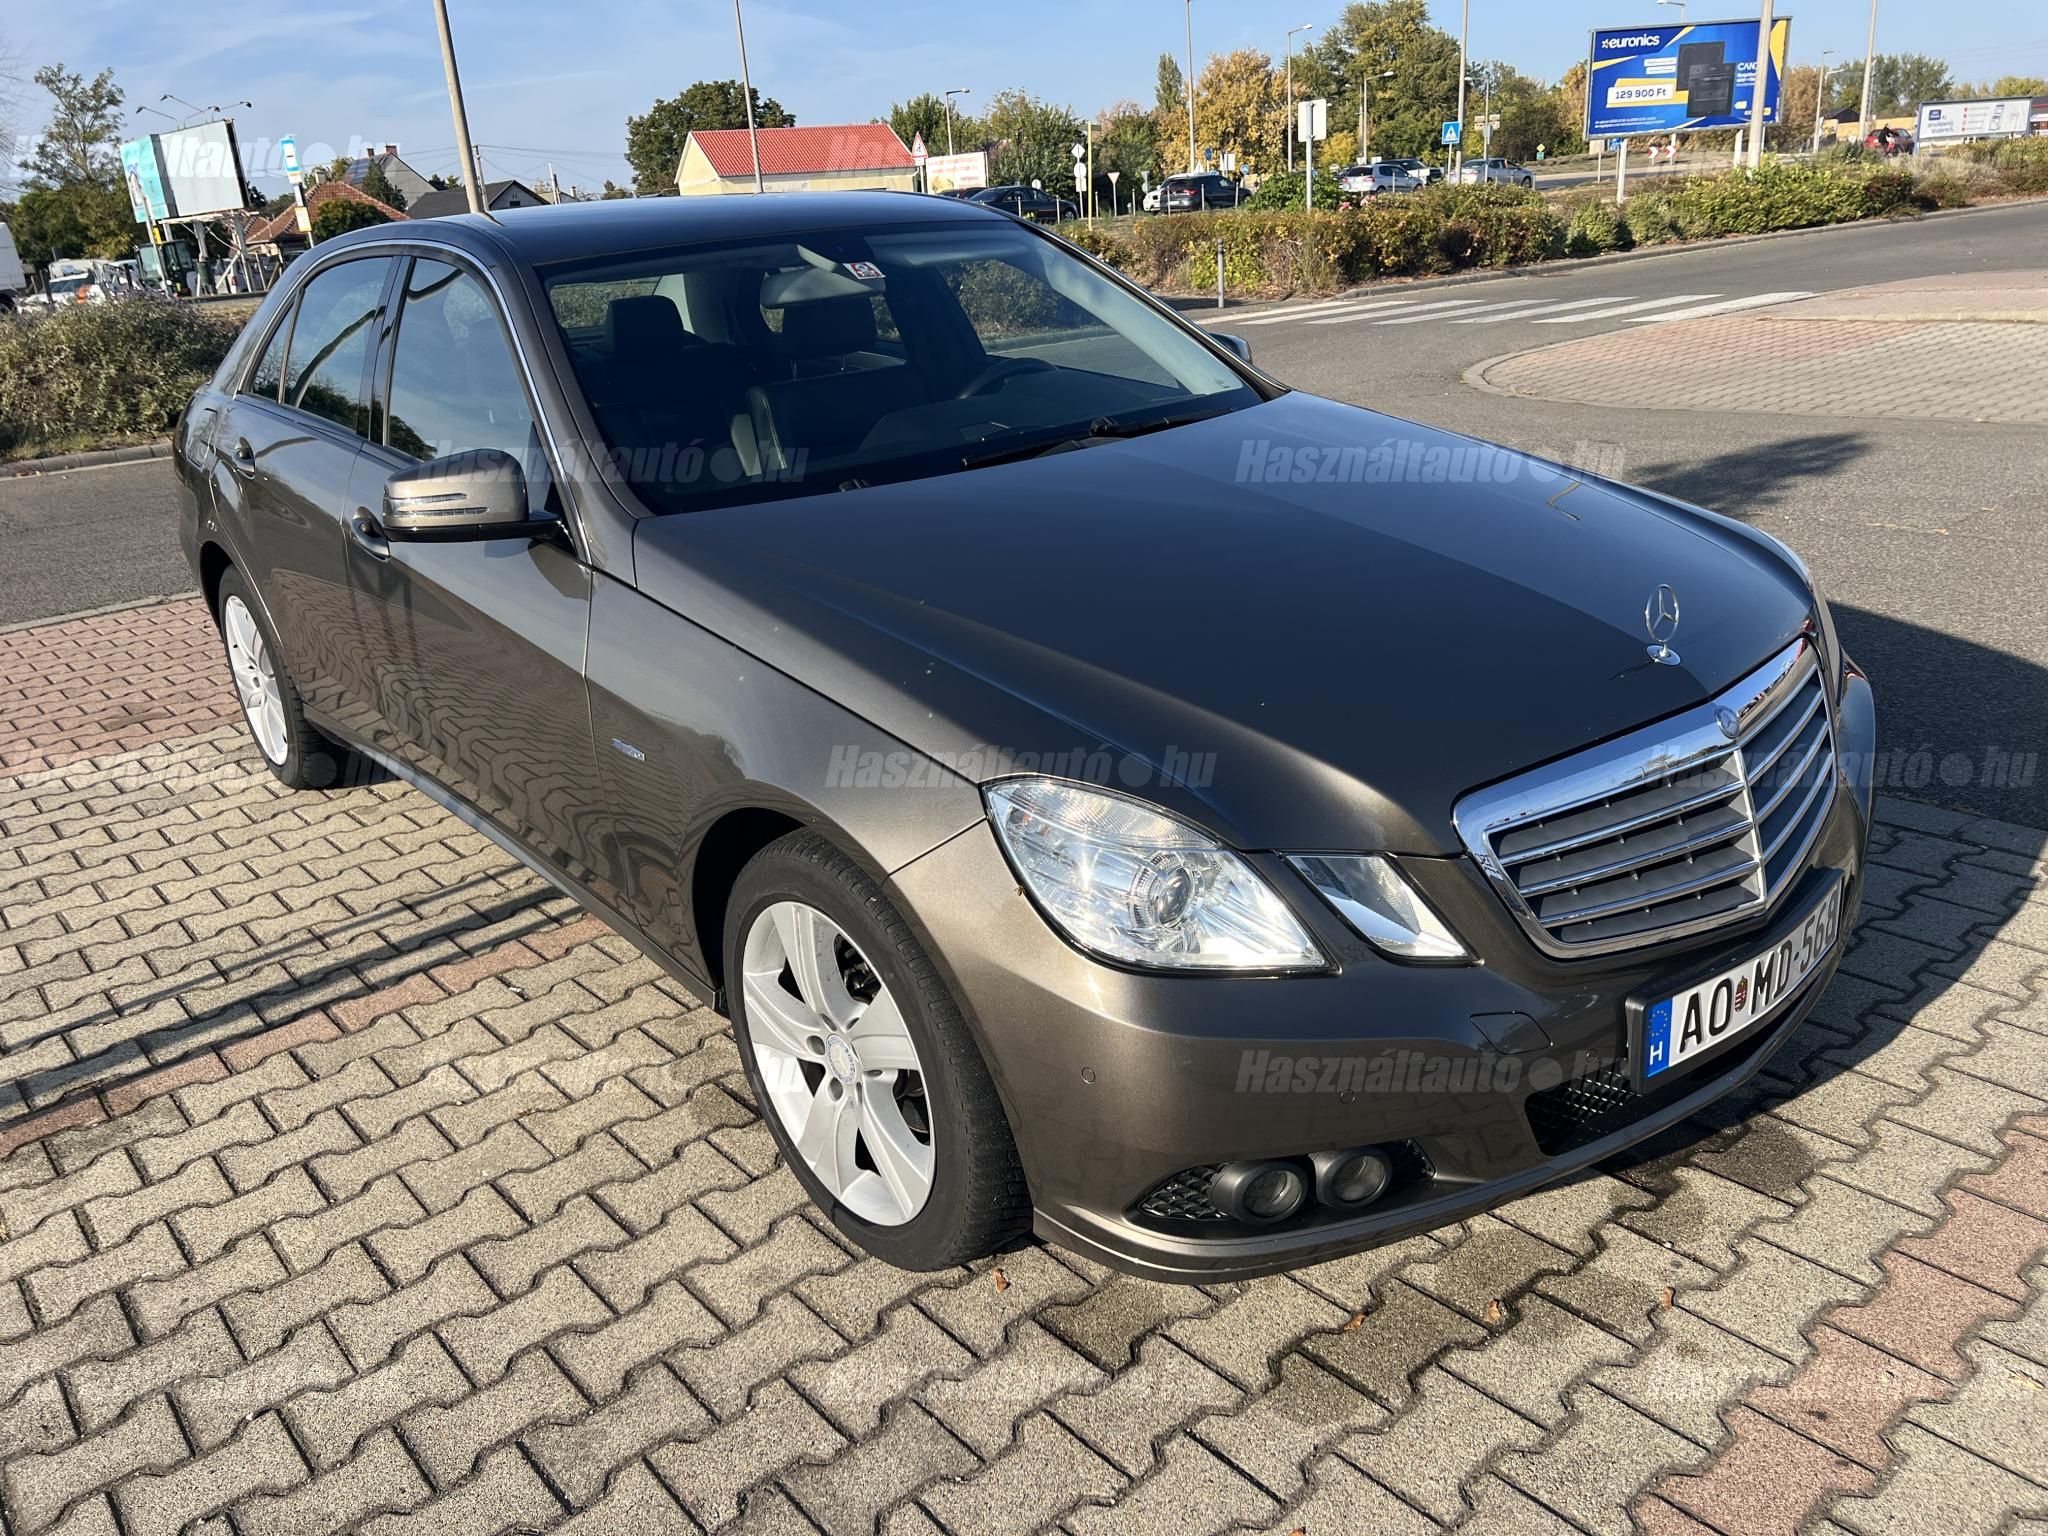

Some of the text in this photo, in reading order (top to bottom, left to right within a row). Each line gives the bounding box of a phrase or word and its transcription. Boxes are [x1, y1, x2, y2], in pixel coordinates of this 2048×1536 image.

[1609, 33, 1660, 49] euronics
[1615, 90, 1633, 100] 129
[1656, 87, 1667, 97] Ft
[1678, 976, 1733, 1054] AO
[1649, 1040, 1663, 1065] H
